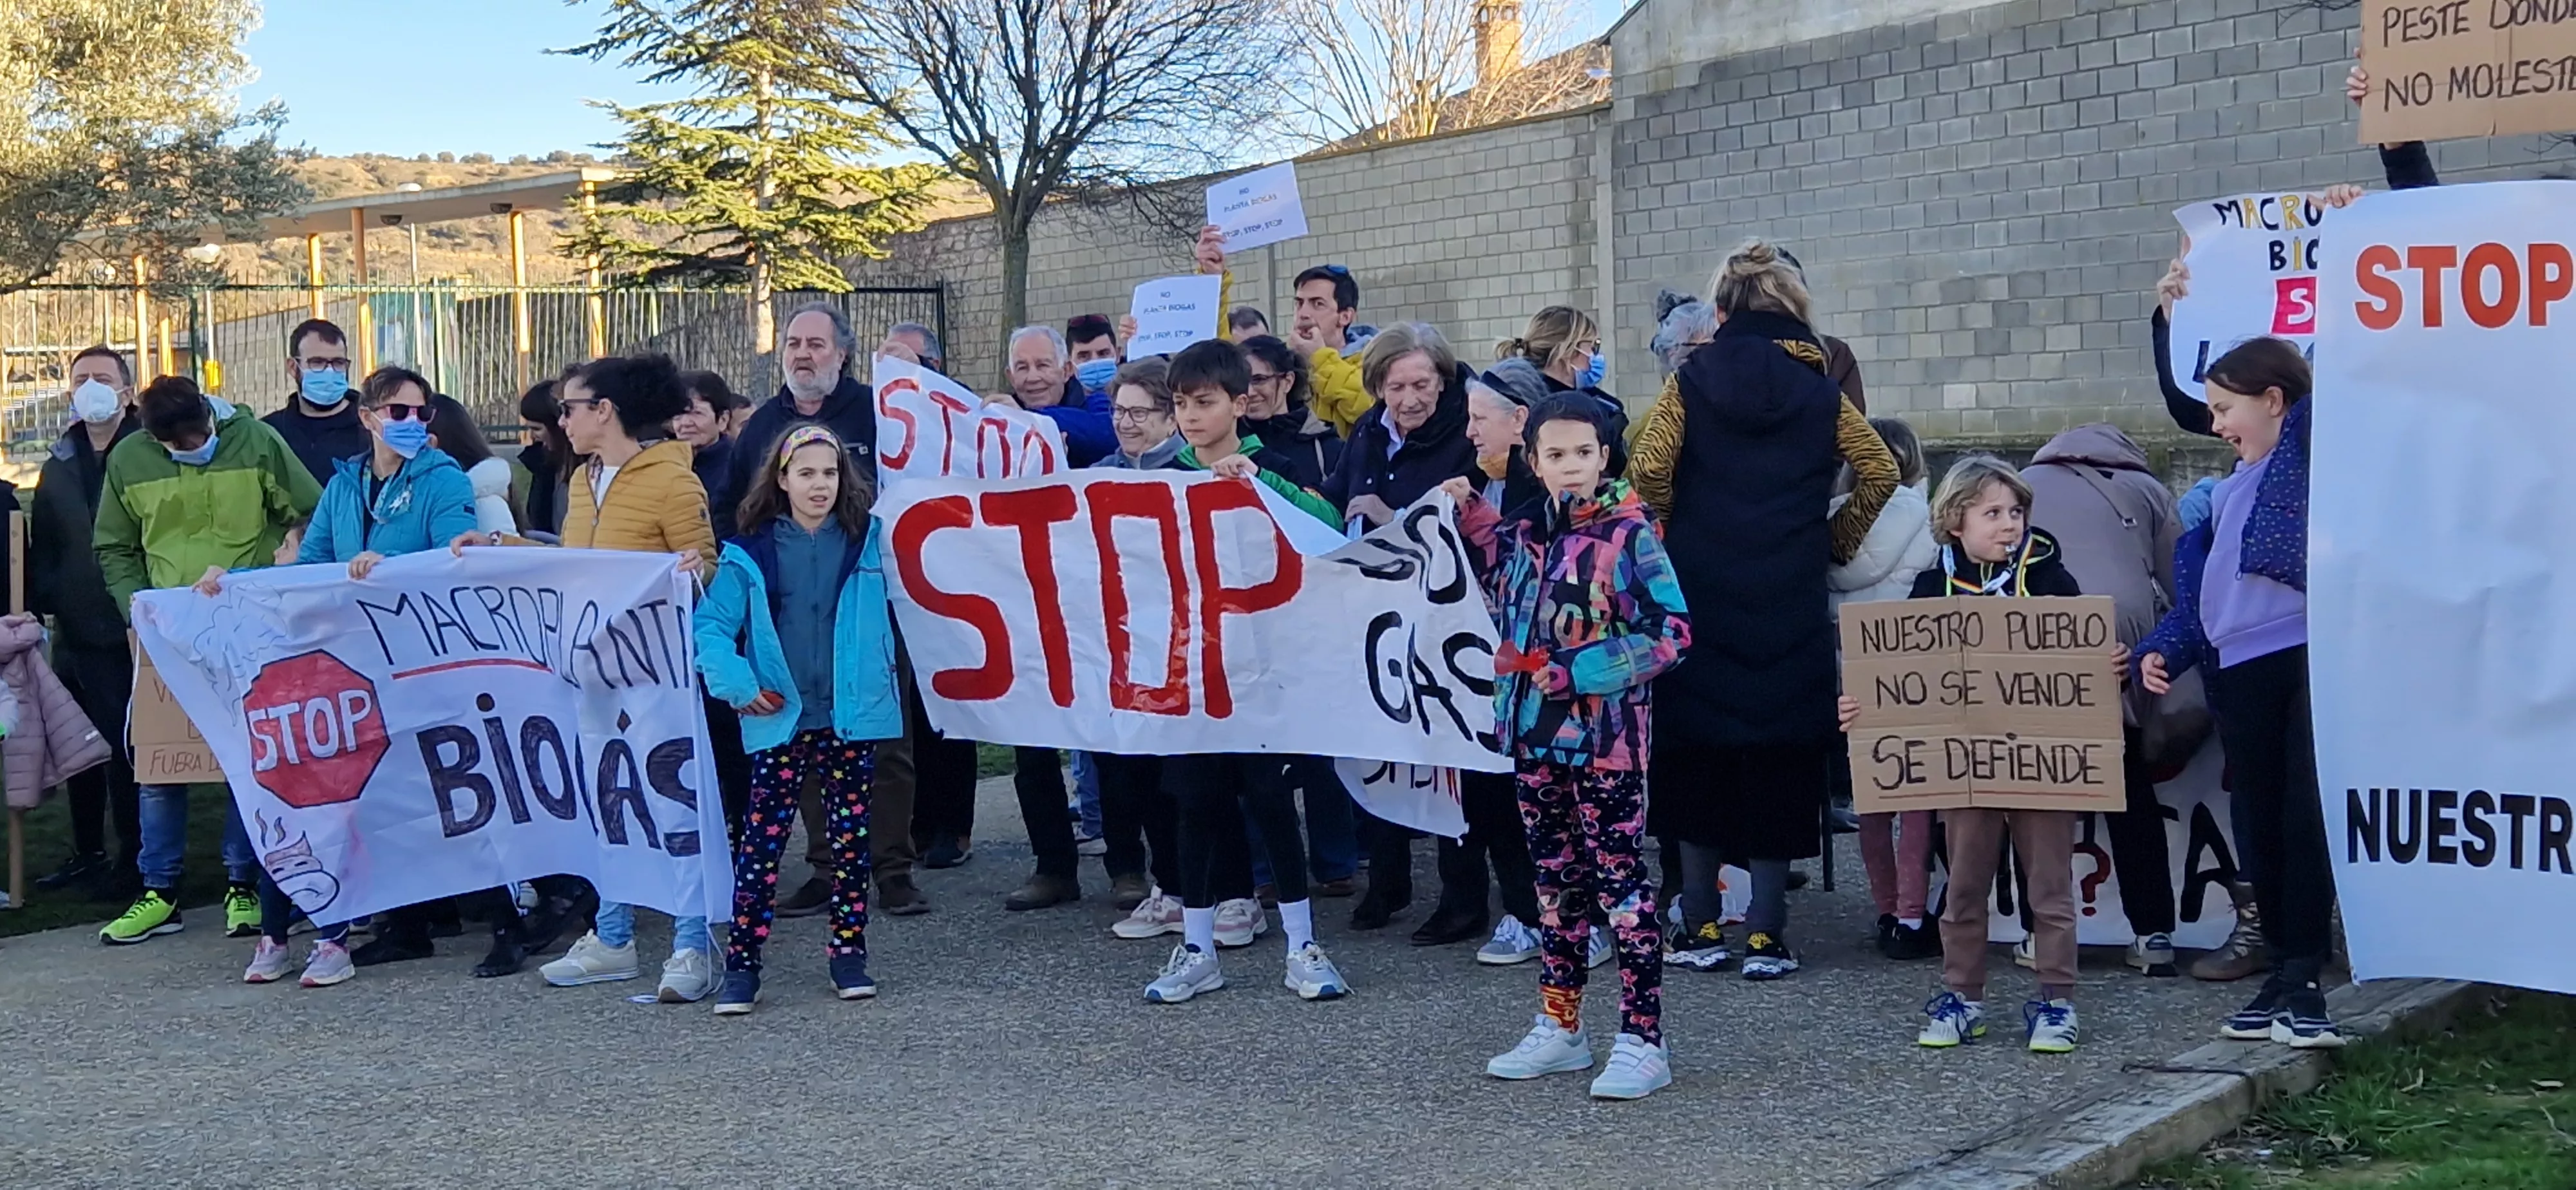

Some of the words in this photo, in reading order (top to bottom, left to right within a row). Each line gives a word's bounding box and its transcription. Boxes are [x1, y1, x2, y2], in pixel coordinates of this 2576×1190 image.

[2383, 0, 2471, 48] PESTE
[2384, 72, 2433, 113] NO
[2354, 242, 2573, 330] STOP
[892, 481, 1304, 719] STOP
[1861, 611, 1984, 654] NUESTRO
[2005, 610, 2107, 651] PUEBLO
[1875, 671, 1927, 708] NO
[1940, 670, 1984, 706] SE
[1994, 672, 2096, 708] VENDE
[249, 689, 372, 772] STOP
[149, 748, 202, 776] FUERA
[1872, 735, 1927, 791] SE
[2347, 788, 2575, 874] NUESTR
